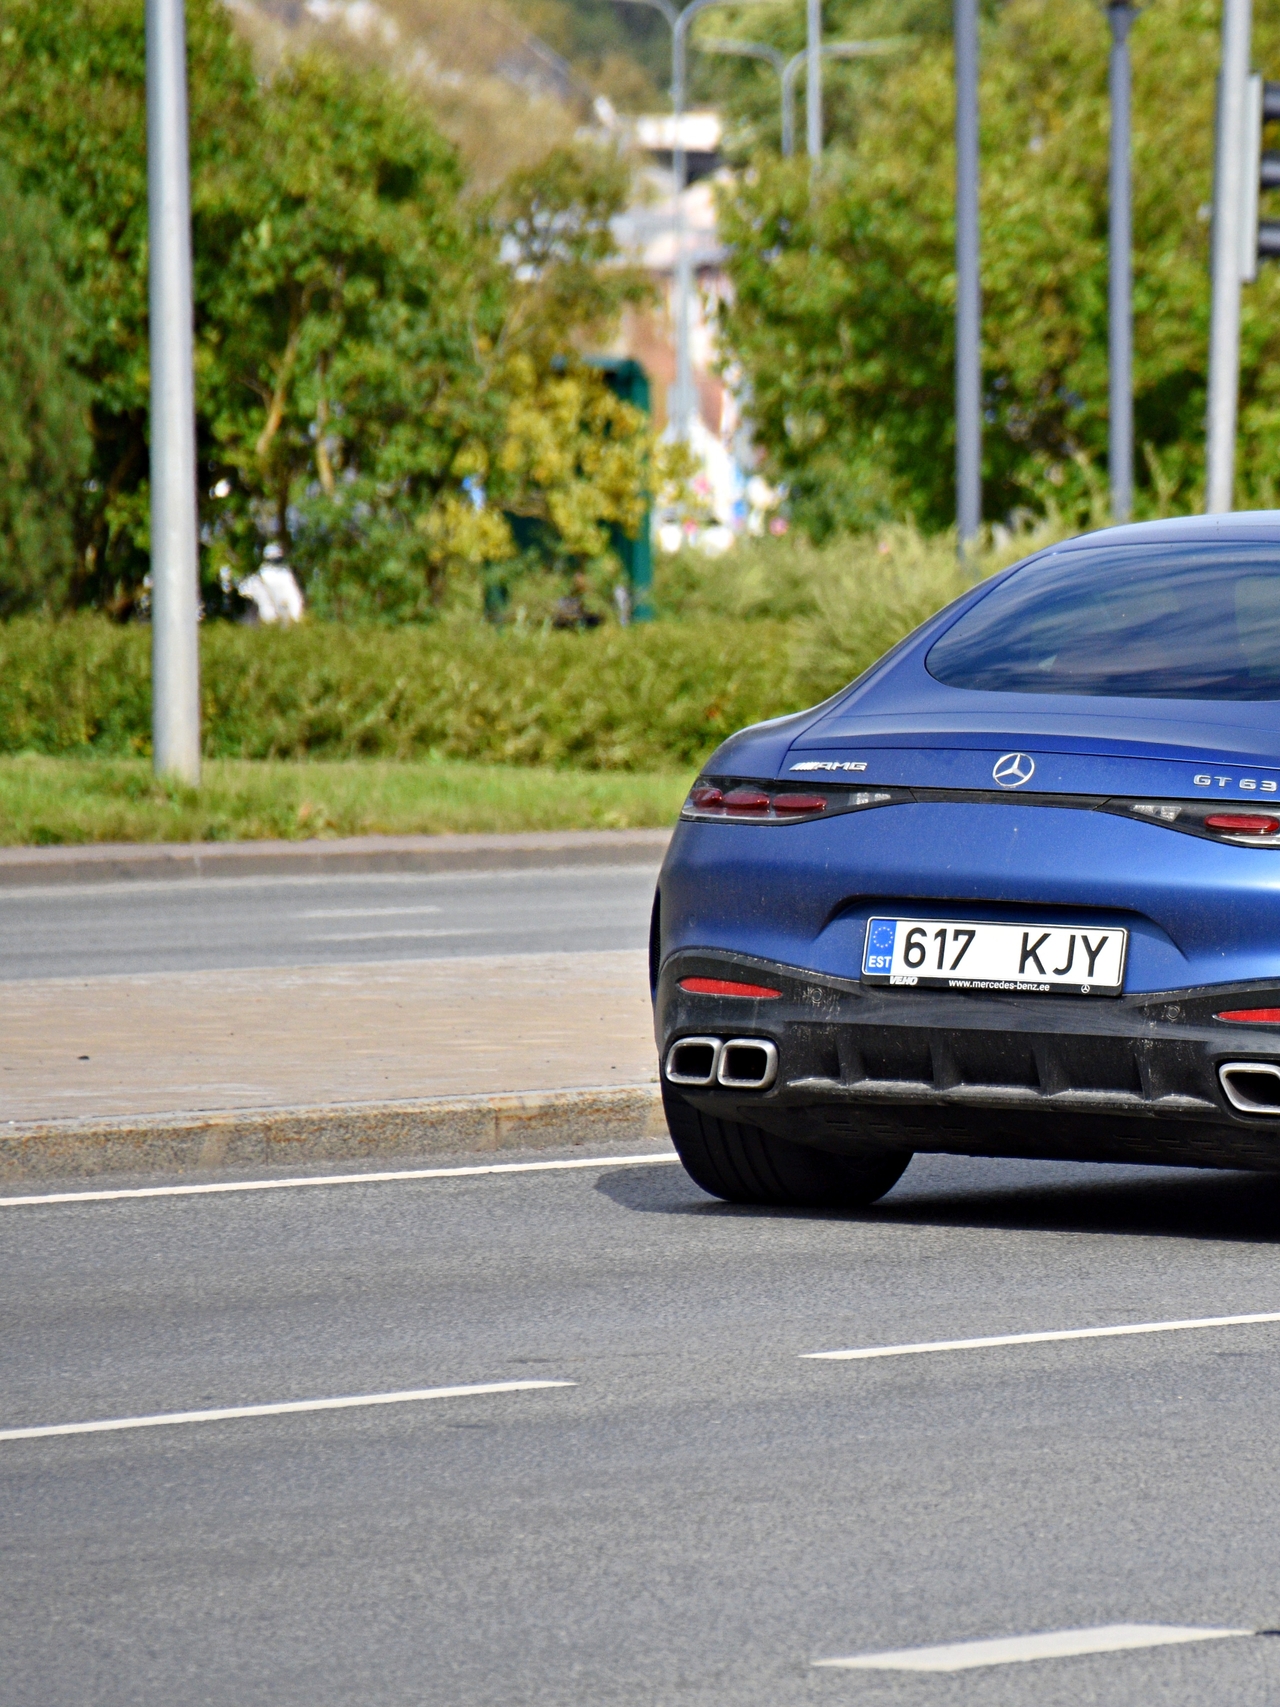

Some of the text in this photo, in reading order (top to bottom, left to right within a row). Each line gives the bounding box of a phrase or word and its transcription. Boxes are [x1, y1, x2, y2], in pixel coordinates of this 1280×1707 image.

[812, 761, 868, 771] AMG
[1193, 774, 1278, 792] GT 63
[903, 927, 1109, 978] 617 KJY
[868, 955, 892, 968] EST
[889, 976, 918, 986] VEHO
[948, 979, 1050, 992] www.mercedes-benz.ee
